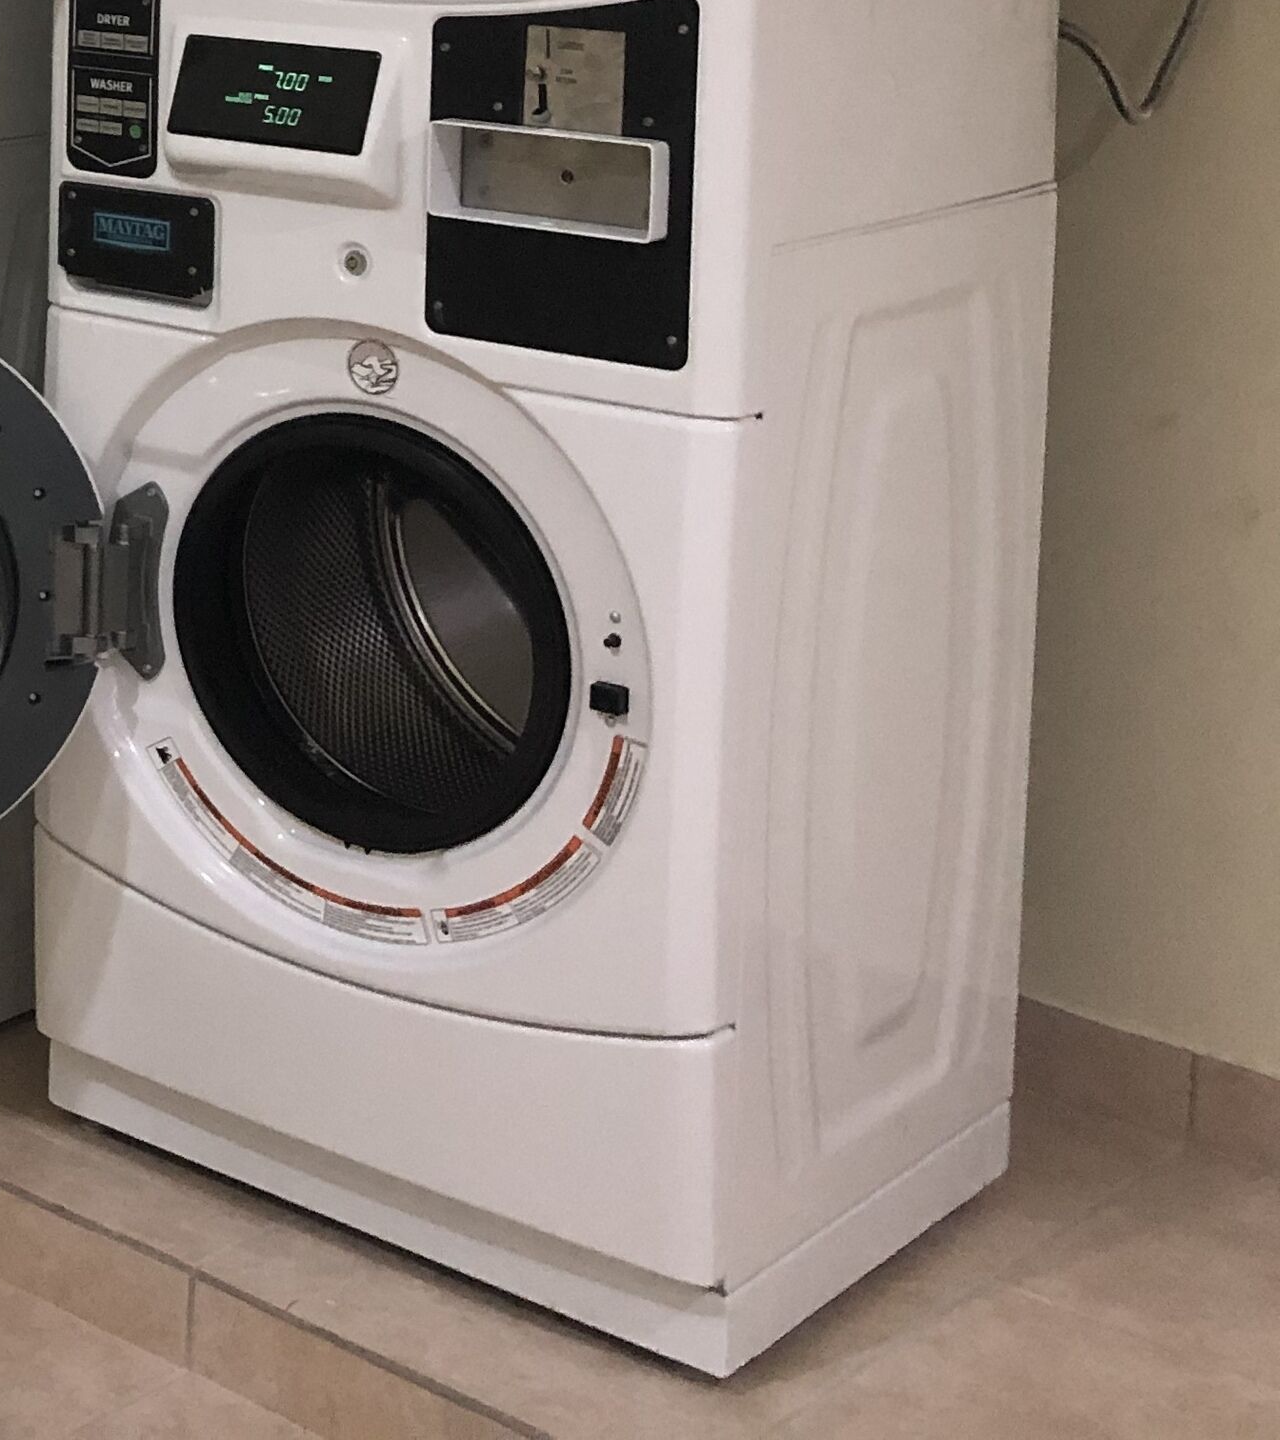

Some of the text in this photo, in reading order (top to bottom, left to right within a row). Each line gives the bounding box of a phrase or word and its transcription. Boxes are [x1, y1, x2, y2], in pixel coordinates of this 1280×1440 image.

[96, 12, 130, 27] DRYER
[90, 77, 133, 93] WASHER
[98, 217, 165, 240] MAYTAG
